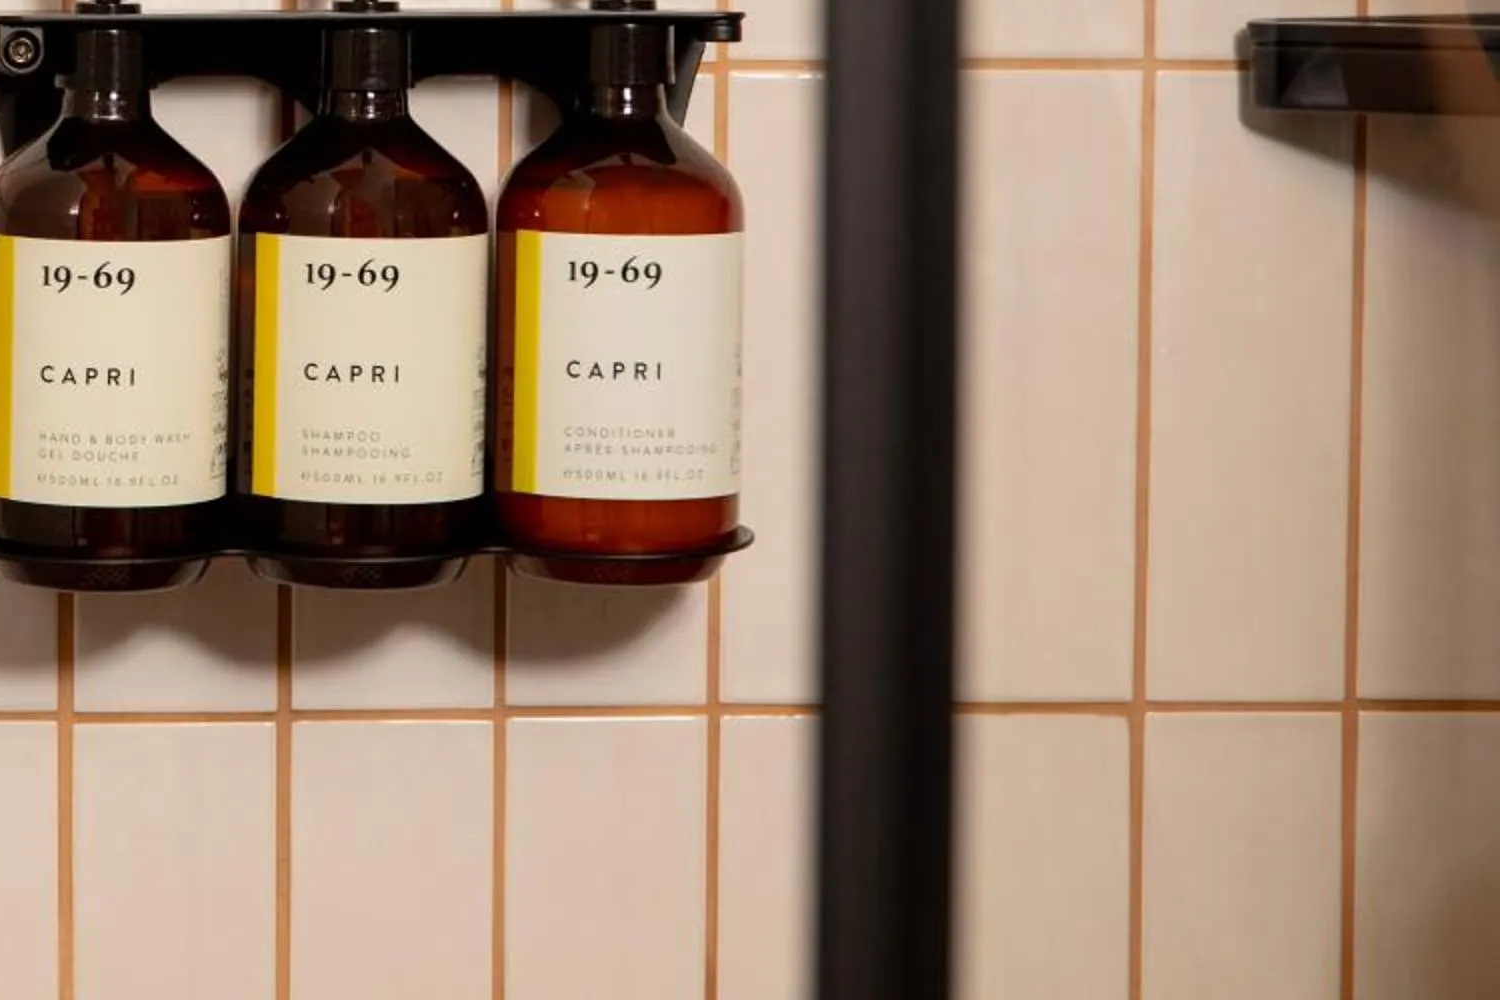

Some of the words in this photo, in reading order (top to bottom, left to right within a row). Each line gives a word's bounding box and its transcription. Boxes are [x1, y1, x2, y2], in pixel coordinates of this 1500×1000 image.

[41, 261, 136, 296] 19-69
[305, 258, 400, 292] 19-69
[567, 256, 663, 290] 19-69
[40, 365, 135, 386] CAPRI
[303, 362, 400, 383] CAPRI
[566, 360, 662, 381] CAPRI
[38, 432, 81, 445] HAND
[105, 434, 148, 446] BODY
[301, 430, 381, 443] SHAMPOO
[563, 426, 676, 439] CONDITIONER
[37, 449, 63, 461] GEL
[72, 450, 140, 462] DOUCHE
[301, 447, 412, 460] SHAMPOOING
